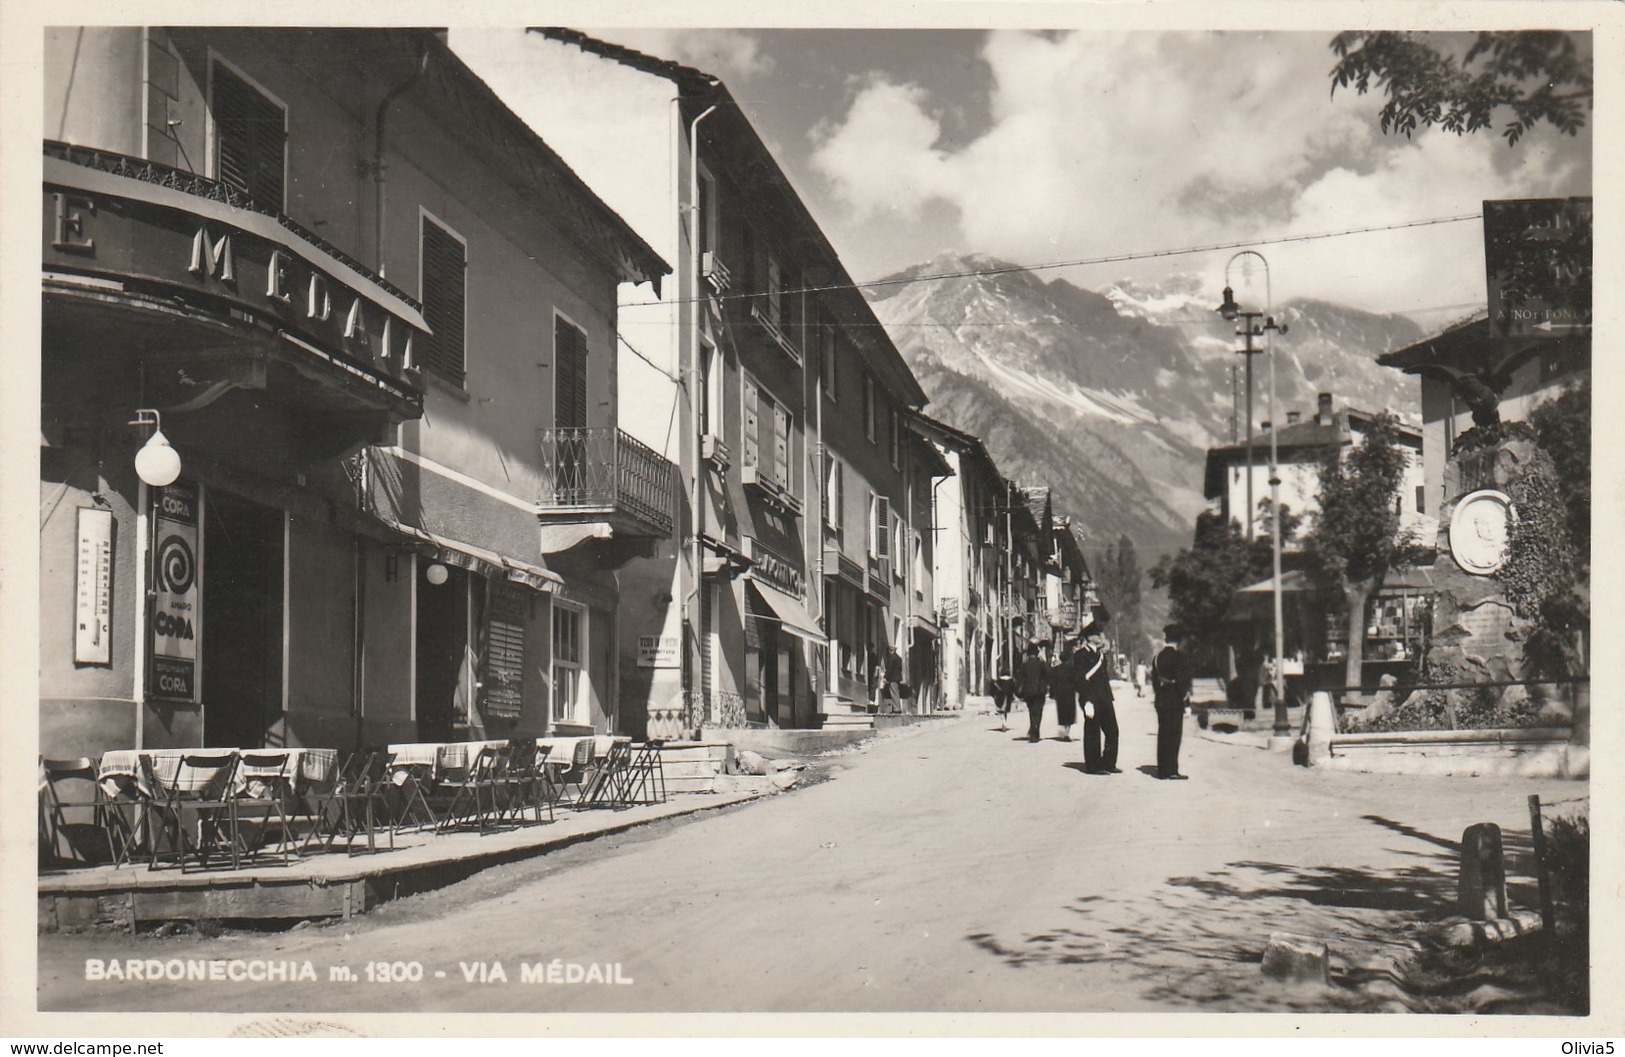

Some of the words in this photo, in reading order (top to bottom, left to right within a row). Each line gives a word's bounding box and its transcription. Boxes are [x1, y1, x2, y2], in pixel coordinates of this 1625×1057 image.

[187, 226, 422, 375] MEDAIL
[162, 496, 190, 518] CORA
[171, 601, 192, 611] AMARO
[155, 610, 194, 641] CORA
[159, 674, 188, 693] CORA
